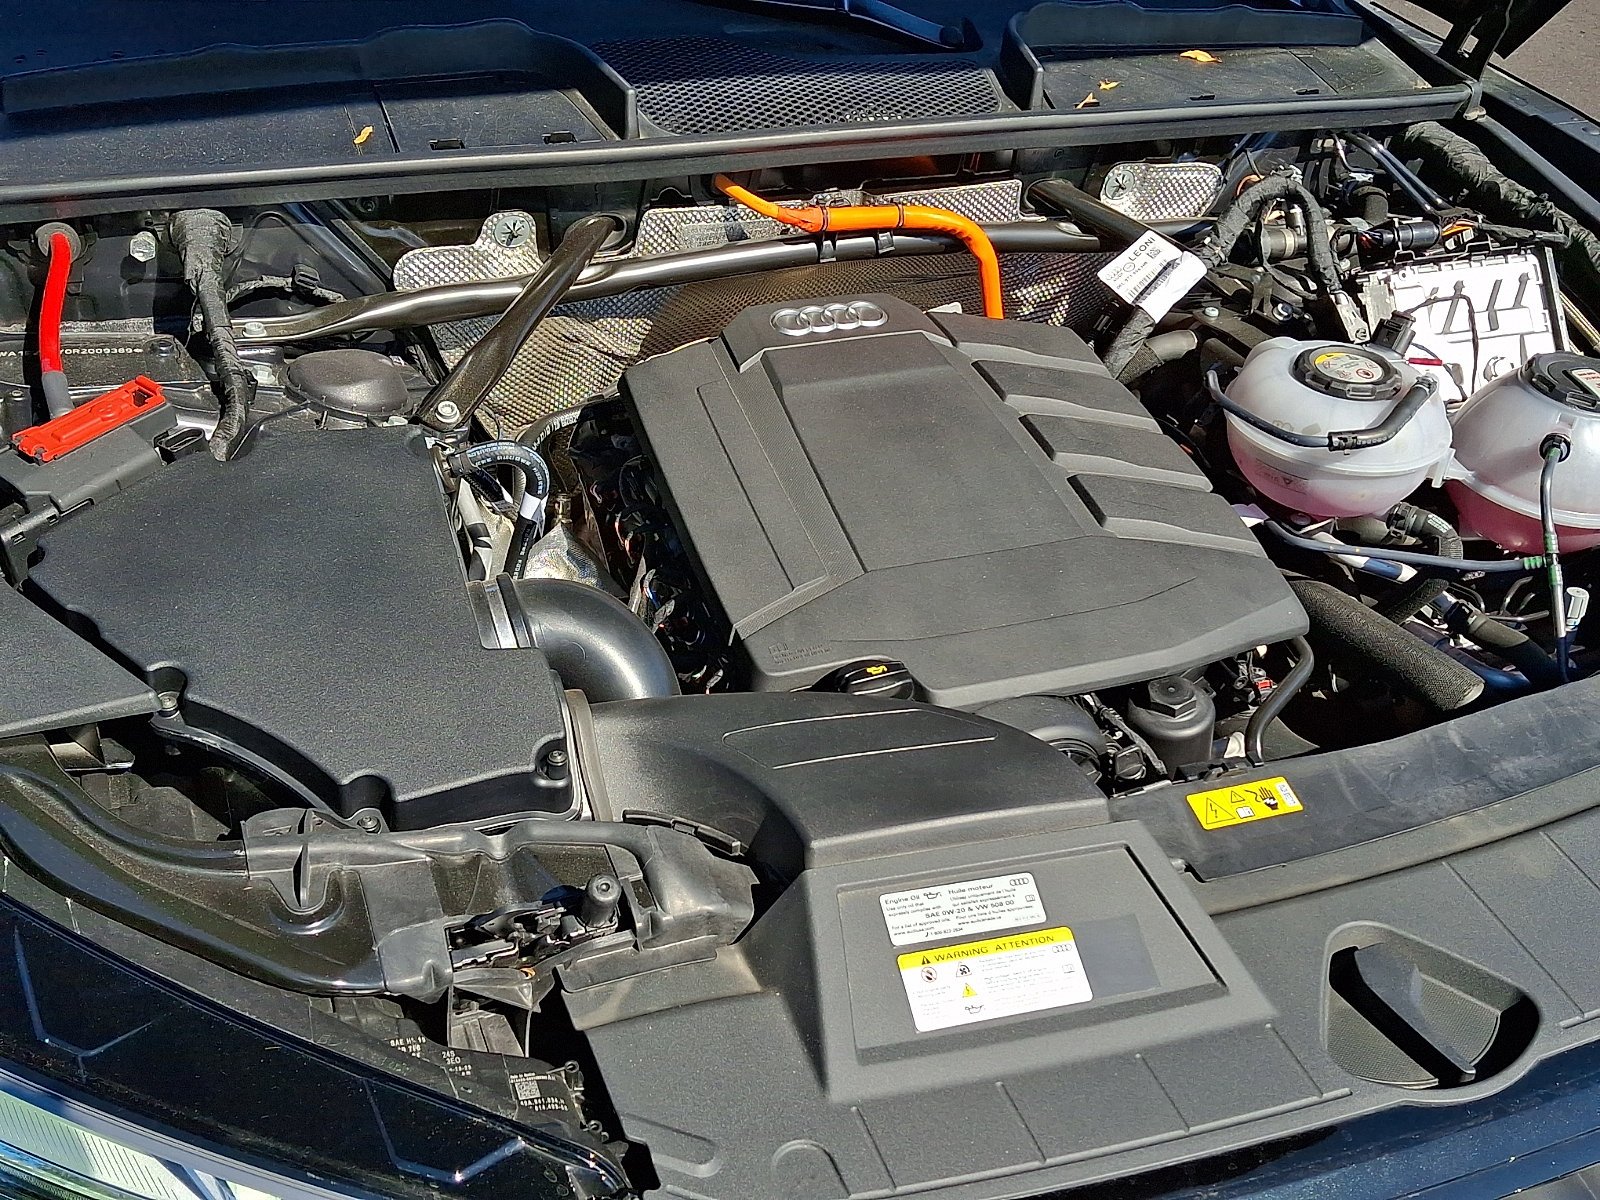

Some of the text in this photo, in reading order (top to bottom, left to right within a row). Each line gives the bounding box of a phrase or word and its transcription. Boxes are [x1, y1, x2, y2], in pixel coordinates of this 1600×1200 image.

[1128, 236, 1156, 262] LEONI
[884, 897, 909, 905] Engine
[925, 911, 940, 919] SAE
[975, 903, 989, 911] VW
[933, 946, 989, 962] WARNING
[995, 935, 1055, 952] ATTENTION
